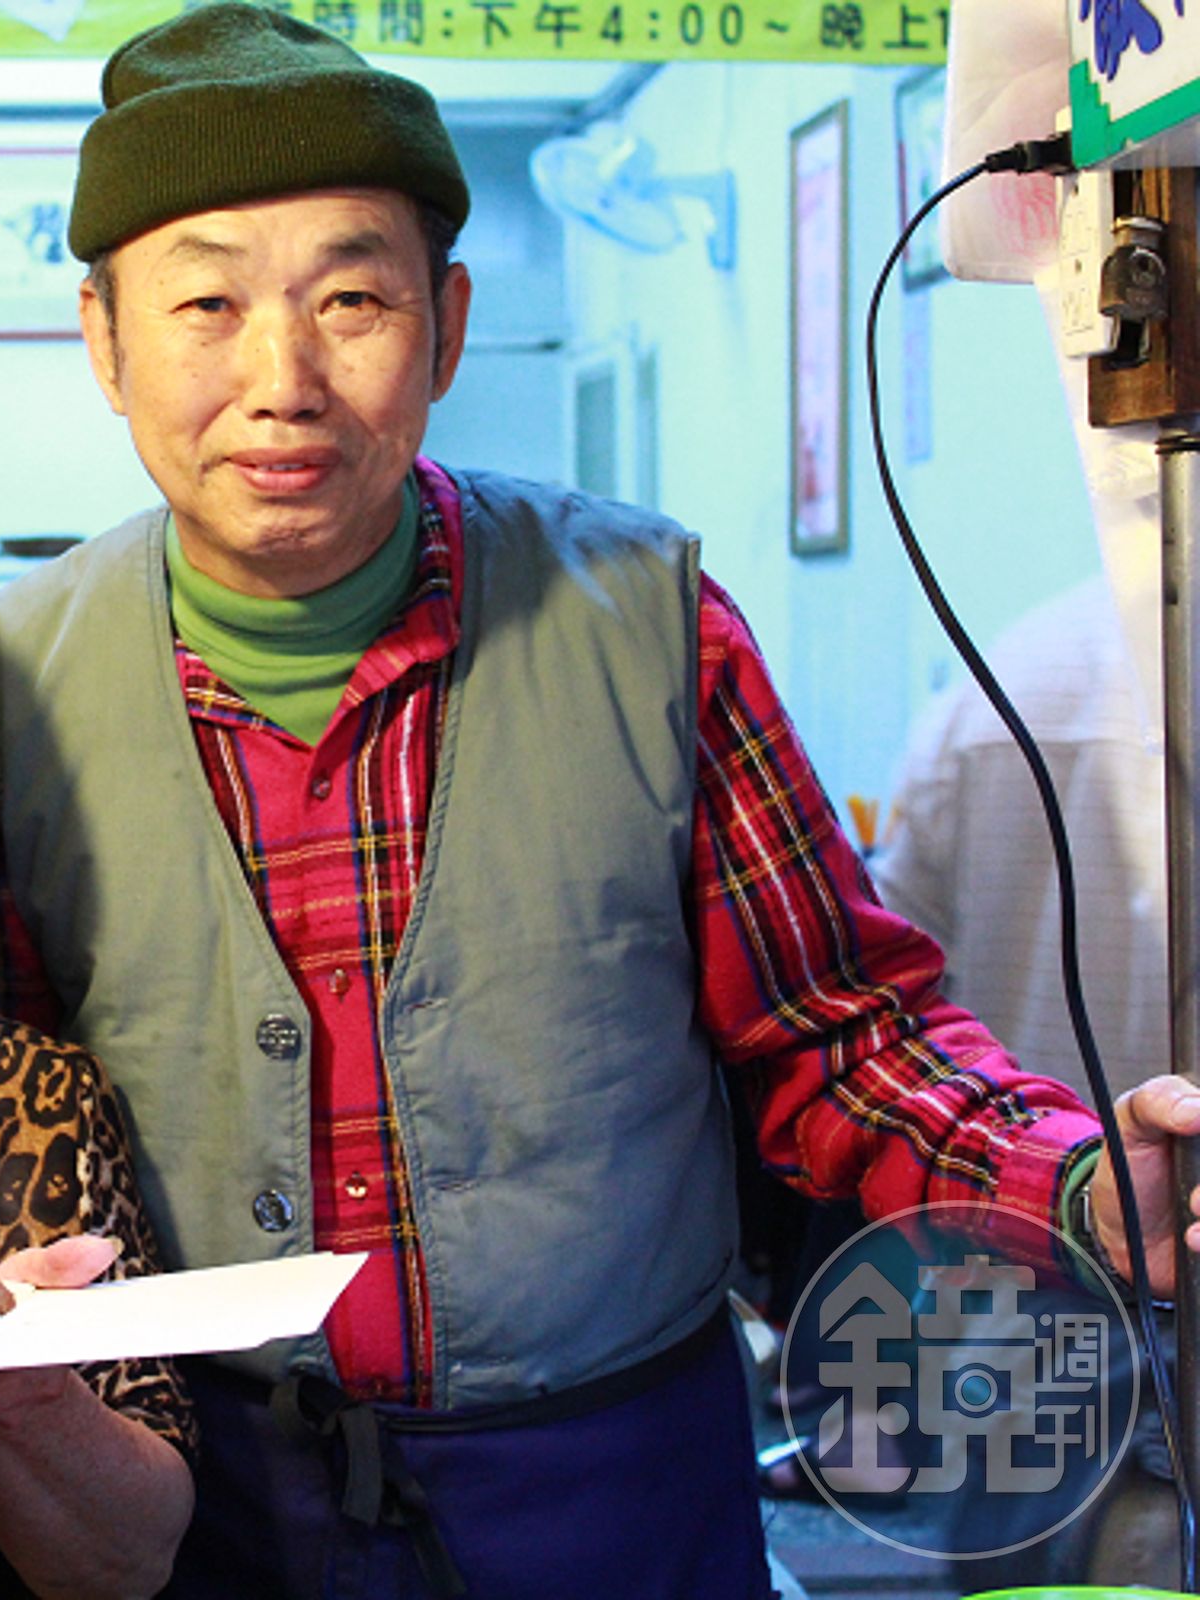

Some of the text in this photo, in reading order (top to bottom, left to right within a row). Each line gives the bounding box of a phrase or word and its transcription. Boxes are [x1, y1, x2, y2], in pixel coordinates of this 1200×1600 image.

[275, 0, 947, 49] 時間:下午4:00~晚上1
